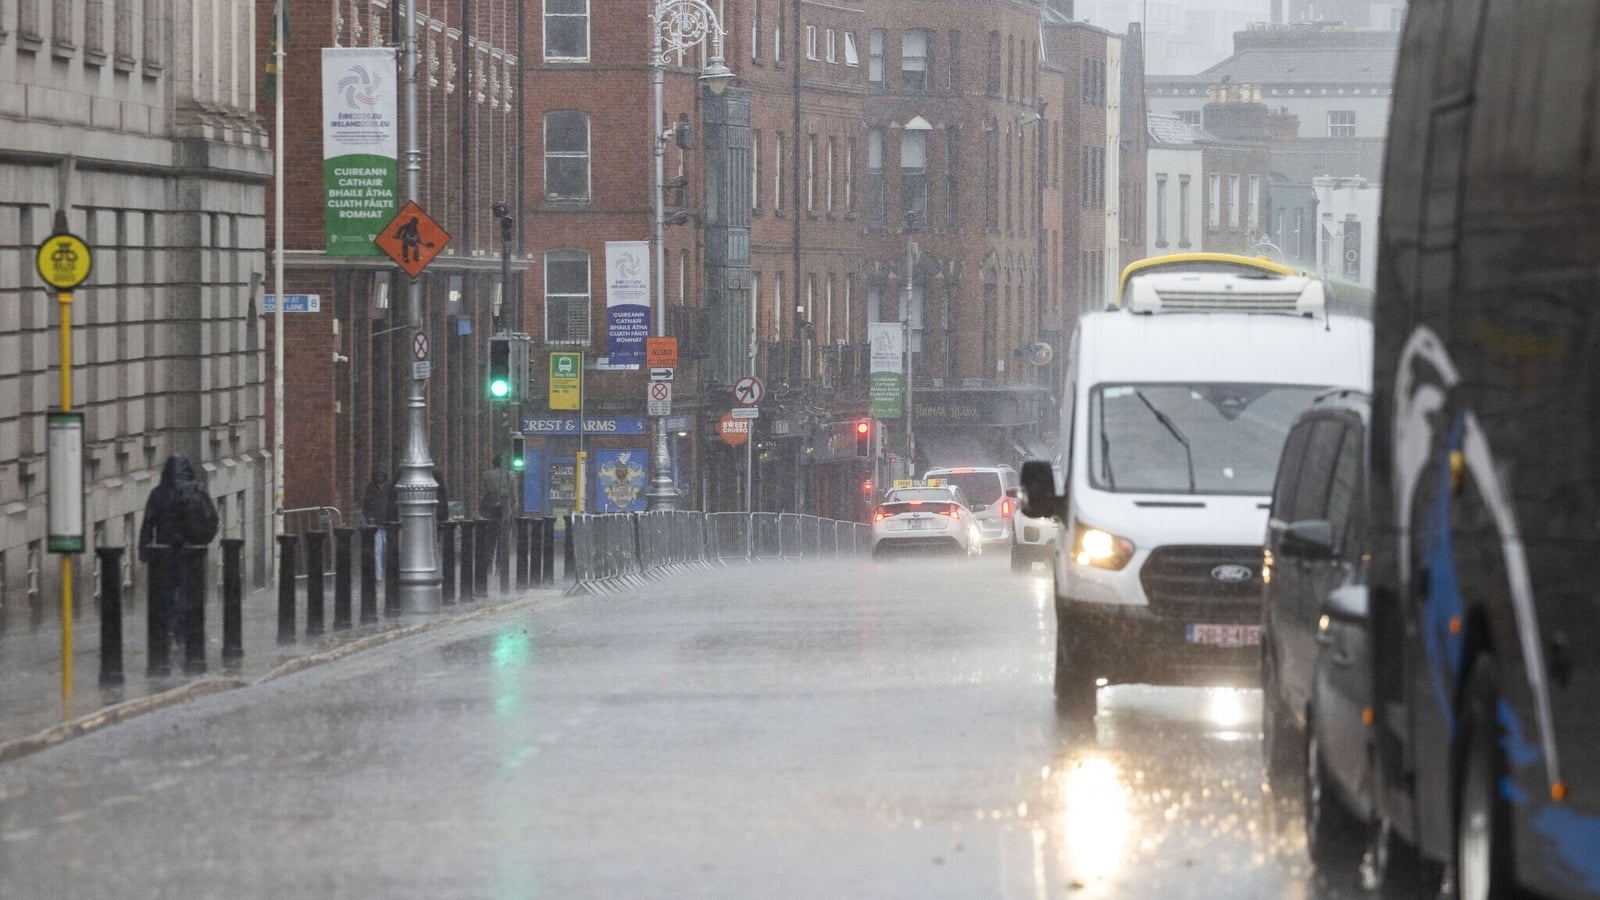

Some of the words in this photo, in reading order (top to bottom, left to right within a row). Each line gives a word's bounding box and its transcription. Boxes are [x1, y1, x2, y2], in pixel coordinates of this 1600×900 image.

[334, 168, 387, 176] CUIREANN
[338, 178, 383, 186] CATHAIR
[328, 189, 363, 197] BHAILE
[365, 187, 392, 197] ÁTHA
[327, 200, 362, 208] CLIATH
[364, 198, 393, 208] FÁILTE
[339, 210, 383, 218] ROMHAT
[565, 420, 575, 431] &
